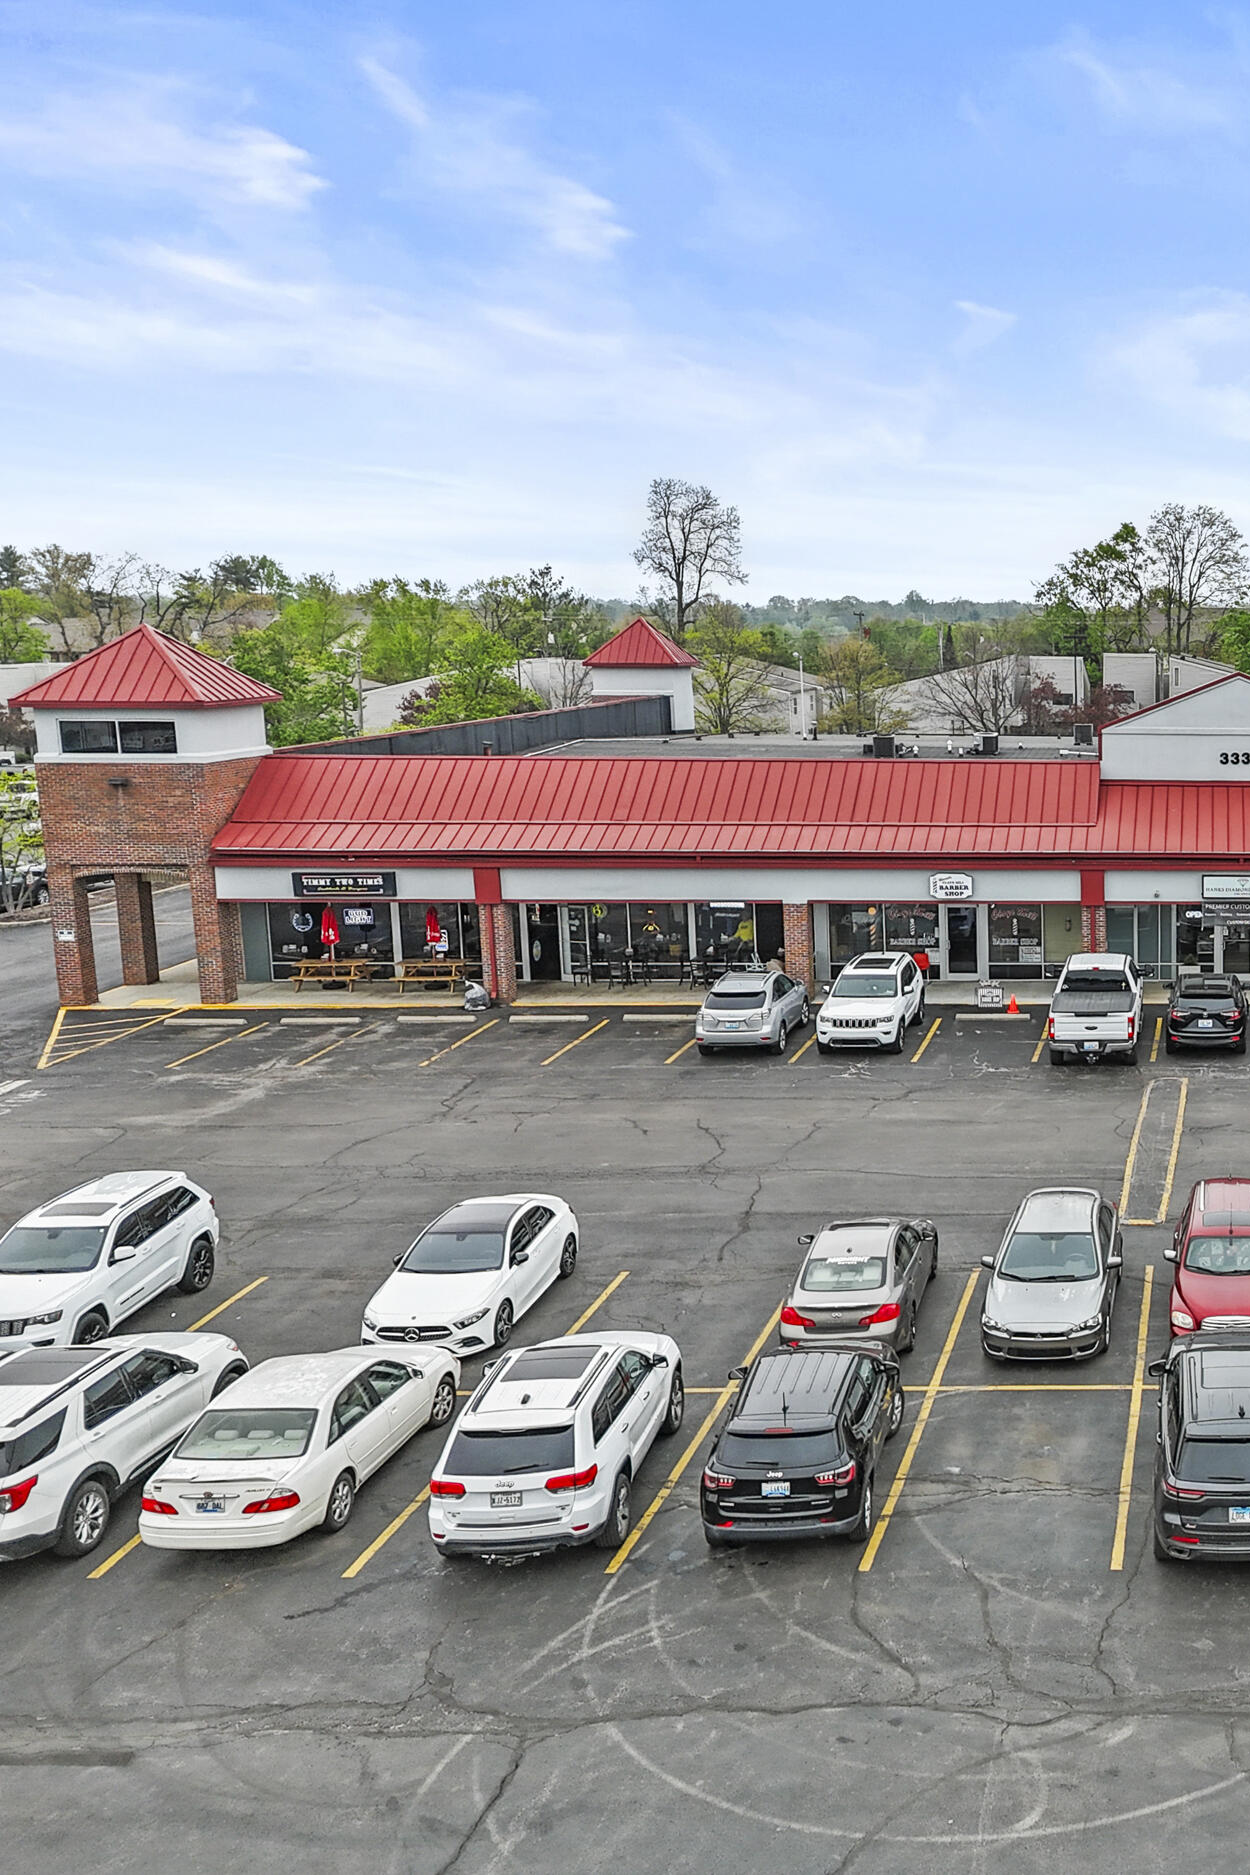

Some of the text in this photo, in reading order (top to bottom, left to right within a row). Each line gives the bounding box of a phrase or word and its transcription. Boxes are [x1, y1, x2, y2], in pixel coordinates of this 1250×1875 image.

[302, 878, 331, 886] TIMMY
[335, 878, 353, 886] TWO
[766, 1470, 784, 1478] Jeep
[495, 1480, 515, 1489] Jeep
